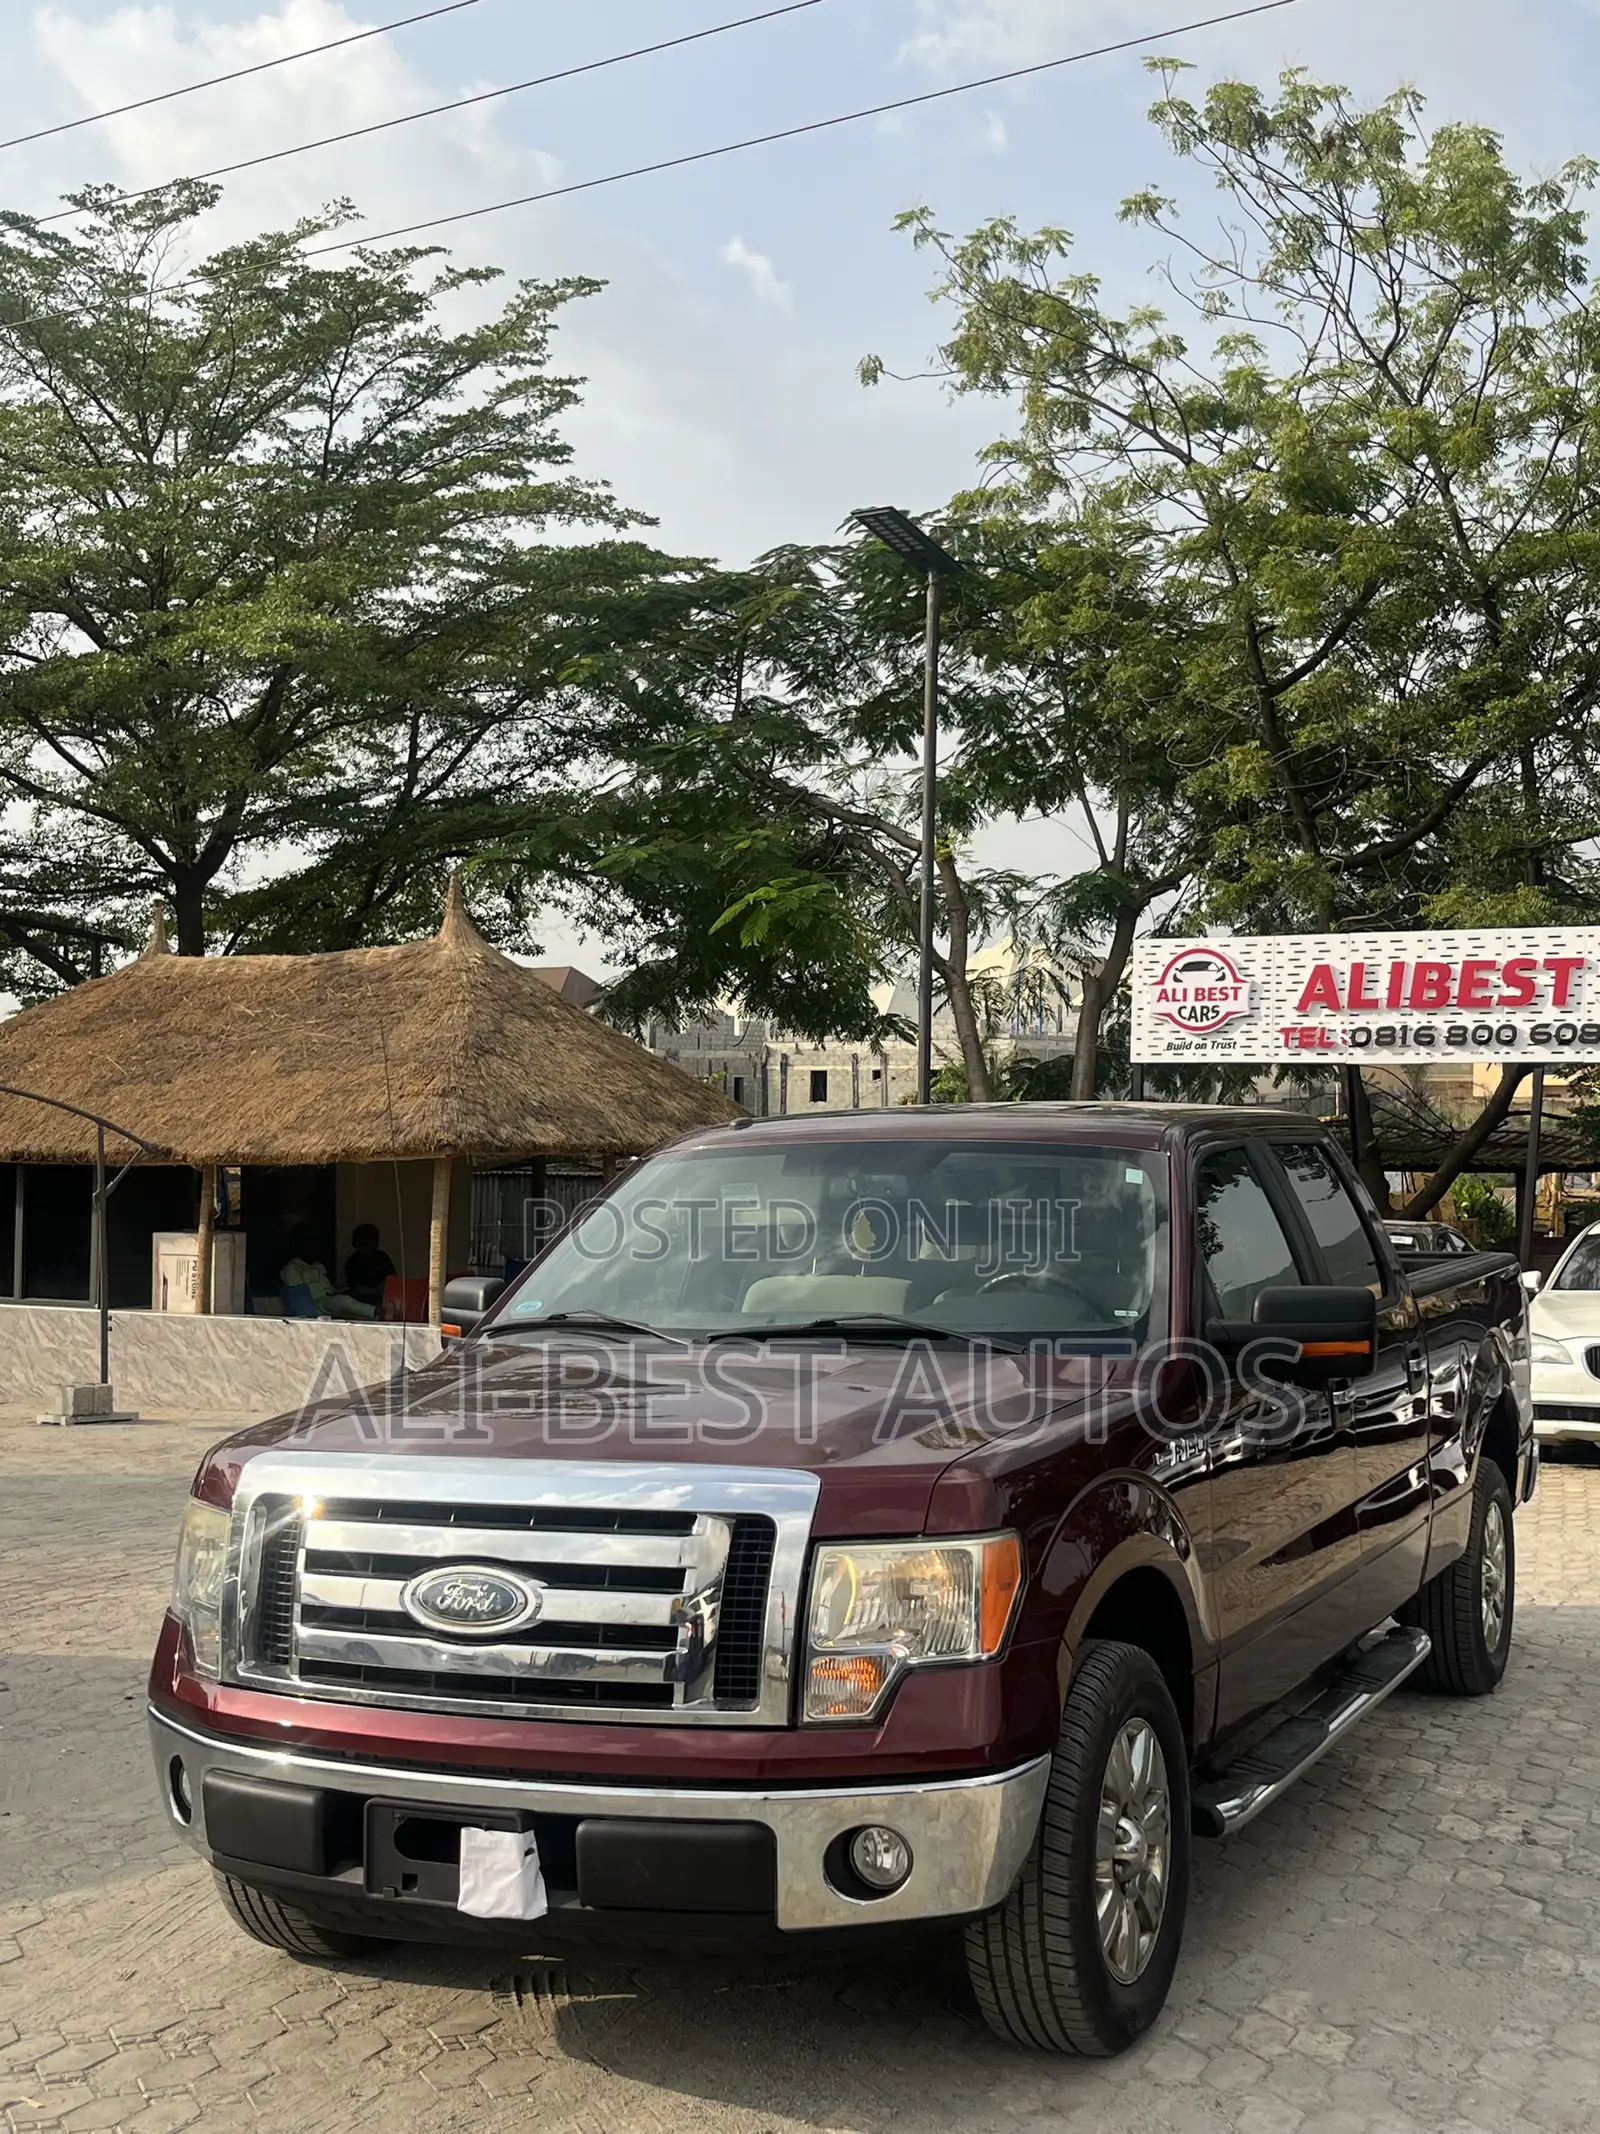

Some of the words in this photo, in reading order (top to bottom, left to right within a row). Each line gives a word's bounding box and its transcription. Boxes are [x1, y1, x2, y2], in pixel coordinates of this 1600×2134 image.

[1156, 988, 1188, 1003] ALI
[1194, 986, 1242, 1002] BEST
[1295, 957, 1585, 1012] ALIBEST
[1177, 1005, 1220, 1022] CARS
[1166, 1041, 1193, 1051] Build
[1211, 1040, 1237, 1050] Trust
[1350, 1024, 1437, 1048] 0816
[1445, 1024, 1518, 1046] 800
[1529, 1022, 1600, 1046] 608
[437, 1581, 494, 1612] Ford
